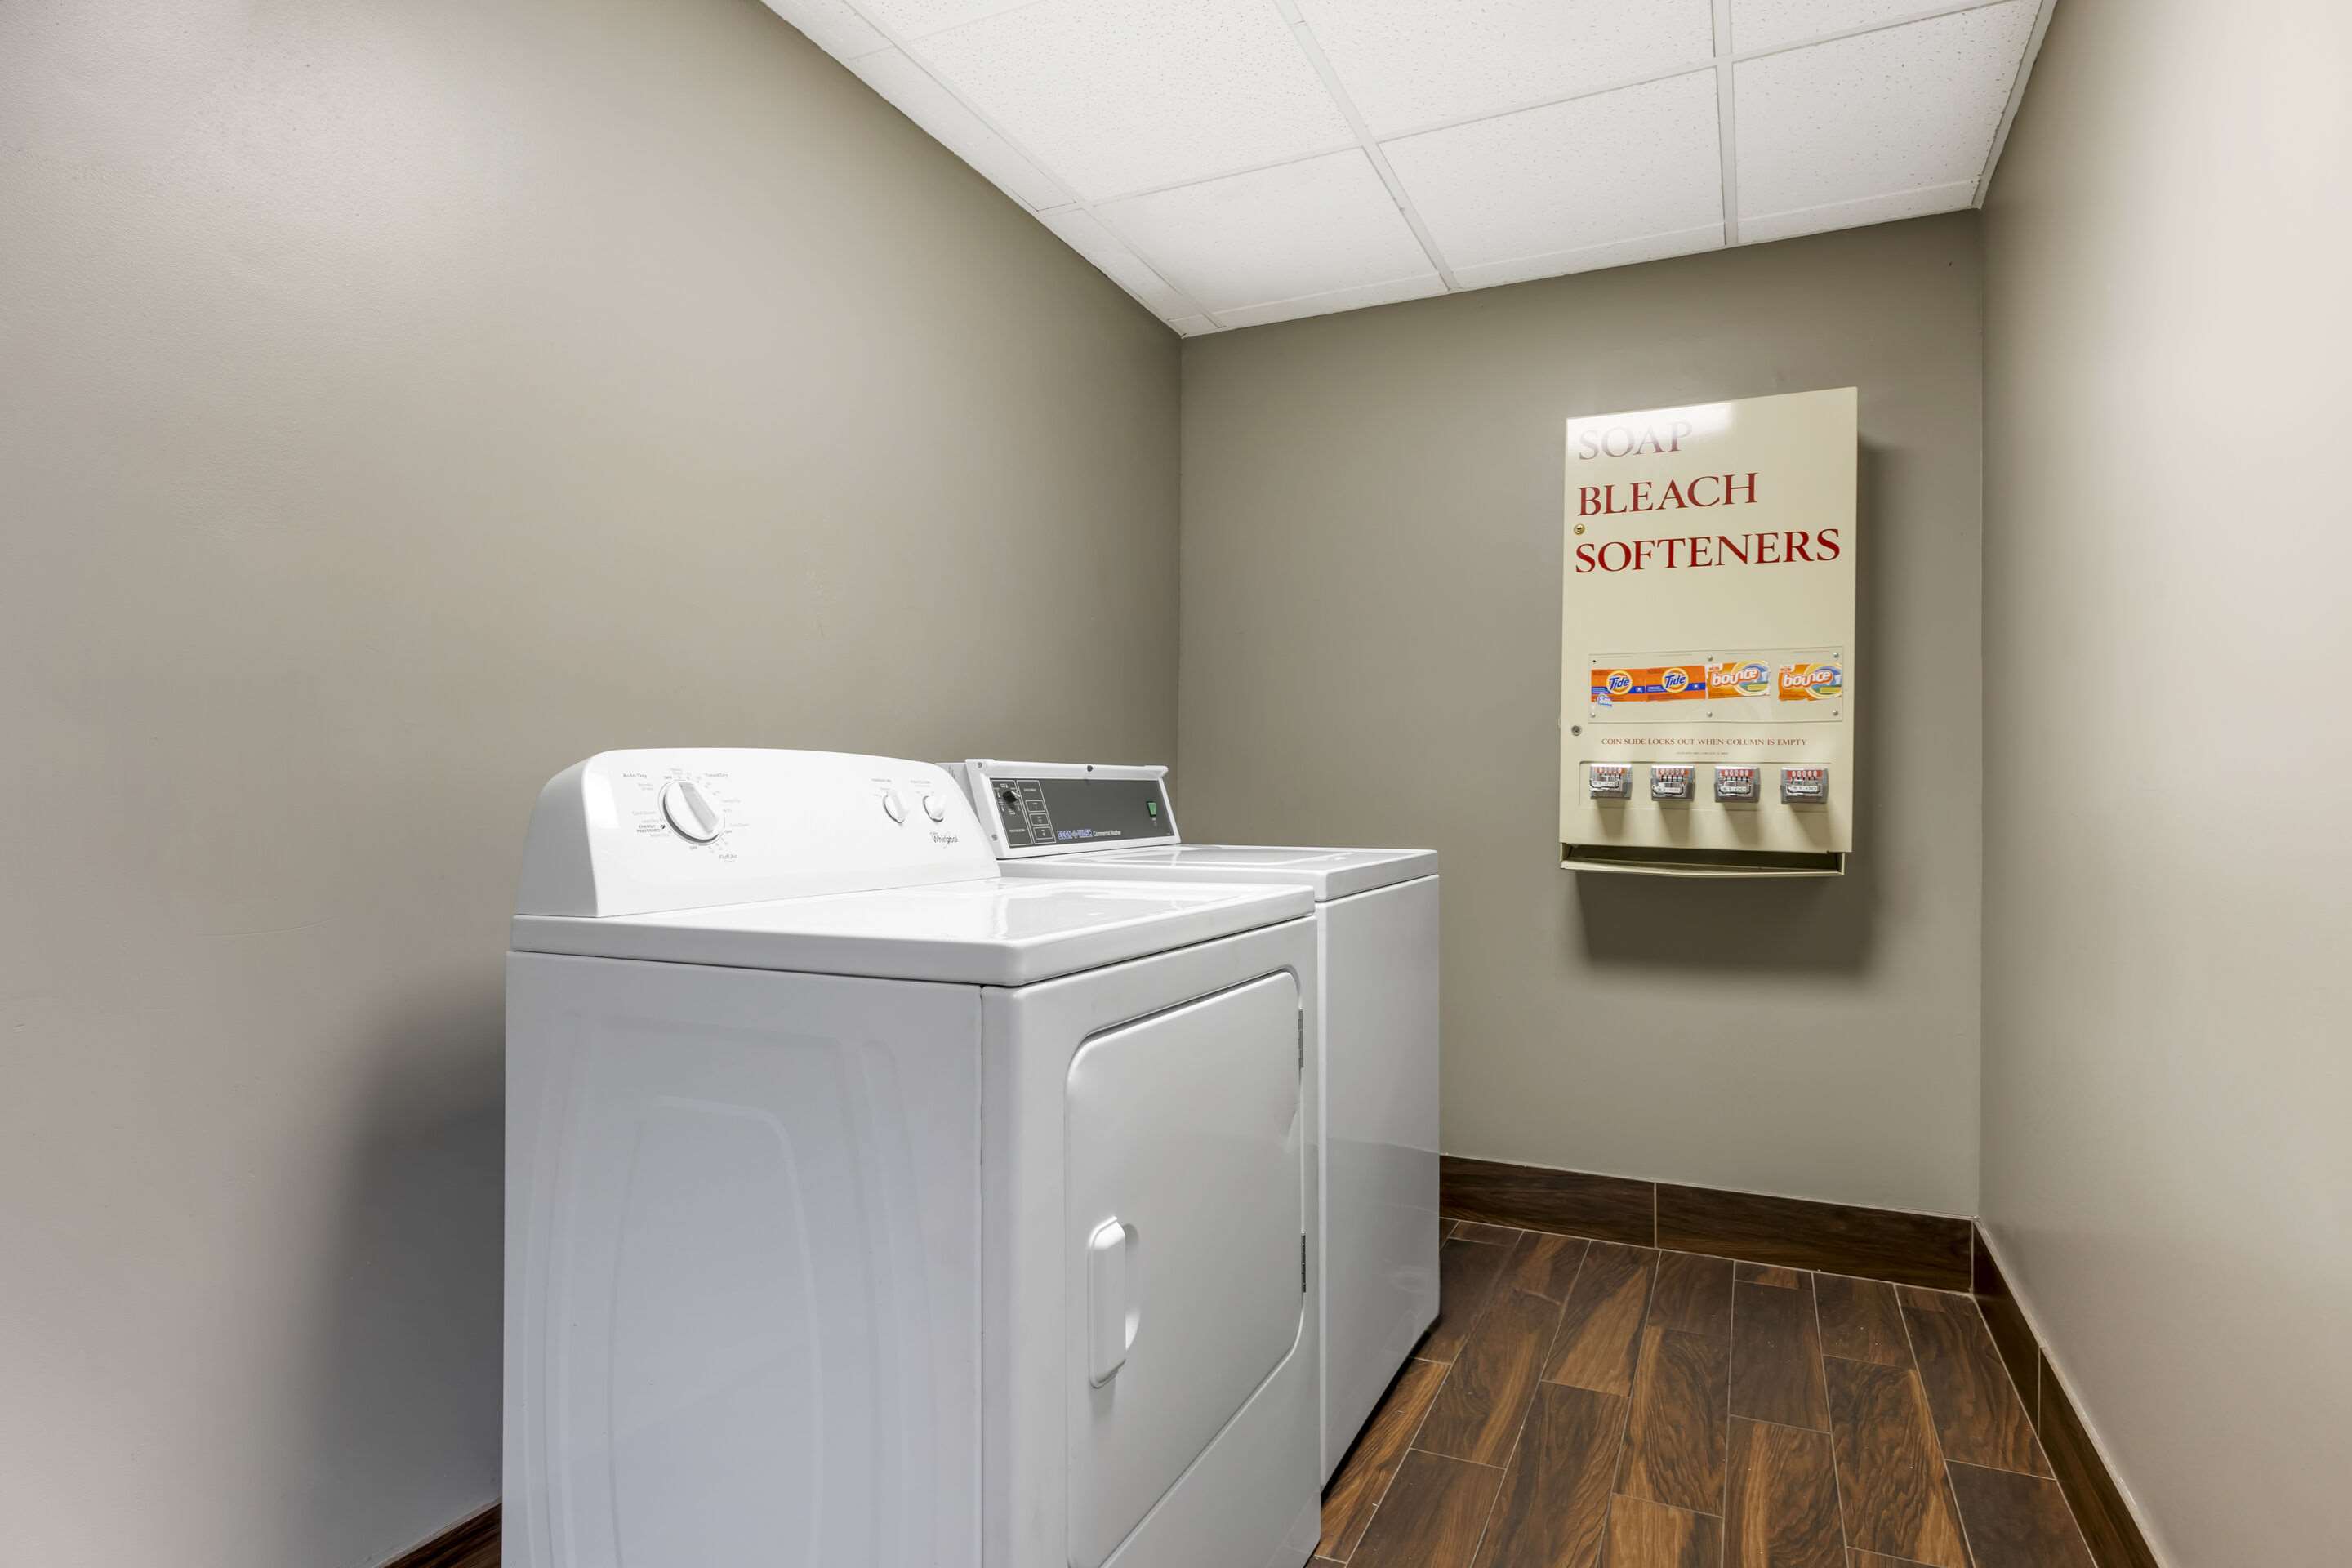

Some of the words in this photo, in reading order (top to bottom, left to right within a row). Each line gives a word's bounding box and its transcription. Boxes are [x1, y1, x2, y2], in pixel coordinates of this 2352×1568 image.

[1579, 418, 1693, 461] SOAP
[1577, 472, 1760, 516] BLEACH
[1575, 528, 1841, 573] SOFTENERS
[1609, 676, 1630, 691] Tide
[1664, 675, 1686, 688] Tide
[1711, 668, 1759, 687] bounce
[1782, 670, 1832, 688] bounce
